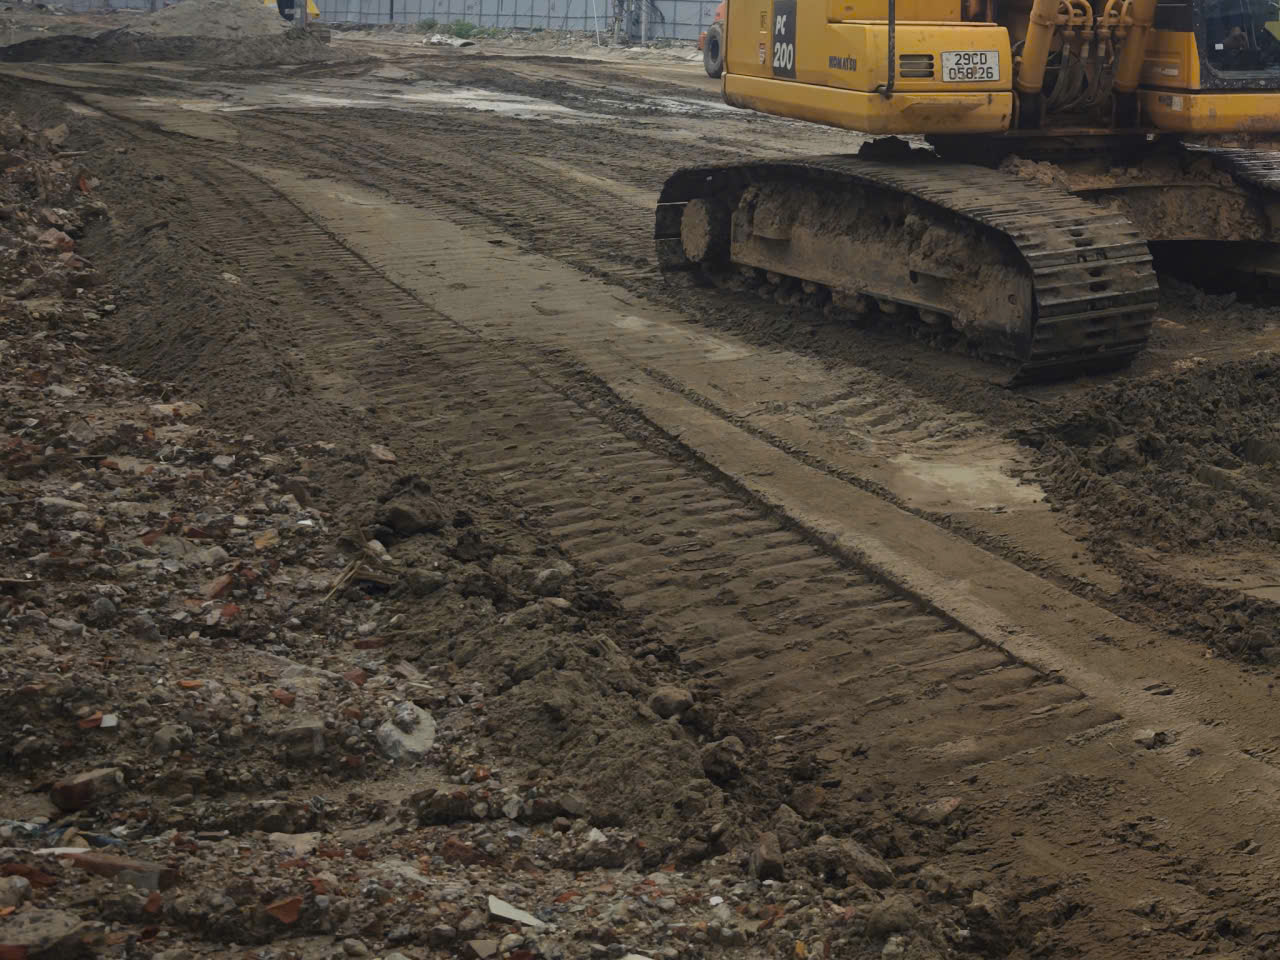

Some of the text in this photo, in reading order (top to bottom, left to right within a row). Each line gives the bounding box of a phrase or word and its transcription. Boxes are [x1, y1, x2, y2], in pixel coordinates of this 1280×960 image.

[775, 14, 787, 35] PC
[773, 42, 794, 71] 200
[828, 54, 857, 72] KOMATSU
[954, 52, 988, 66] 29CD
